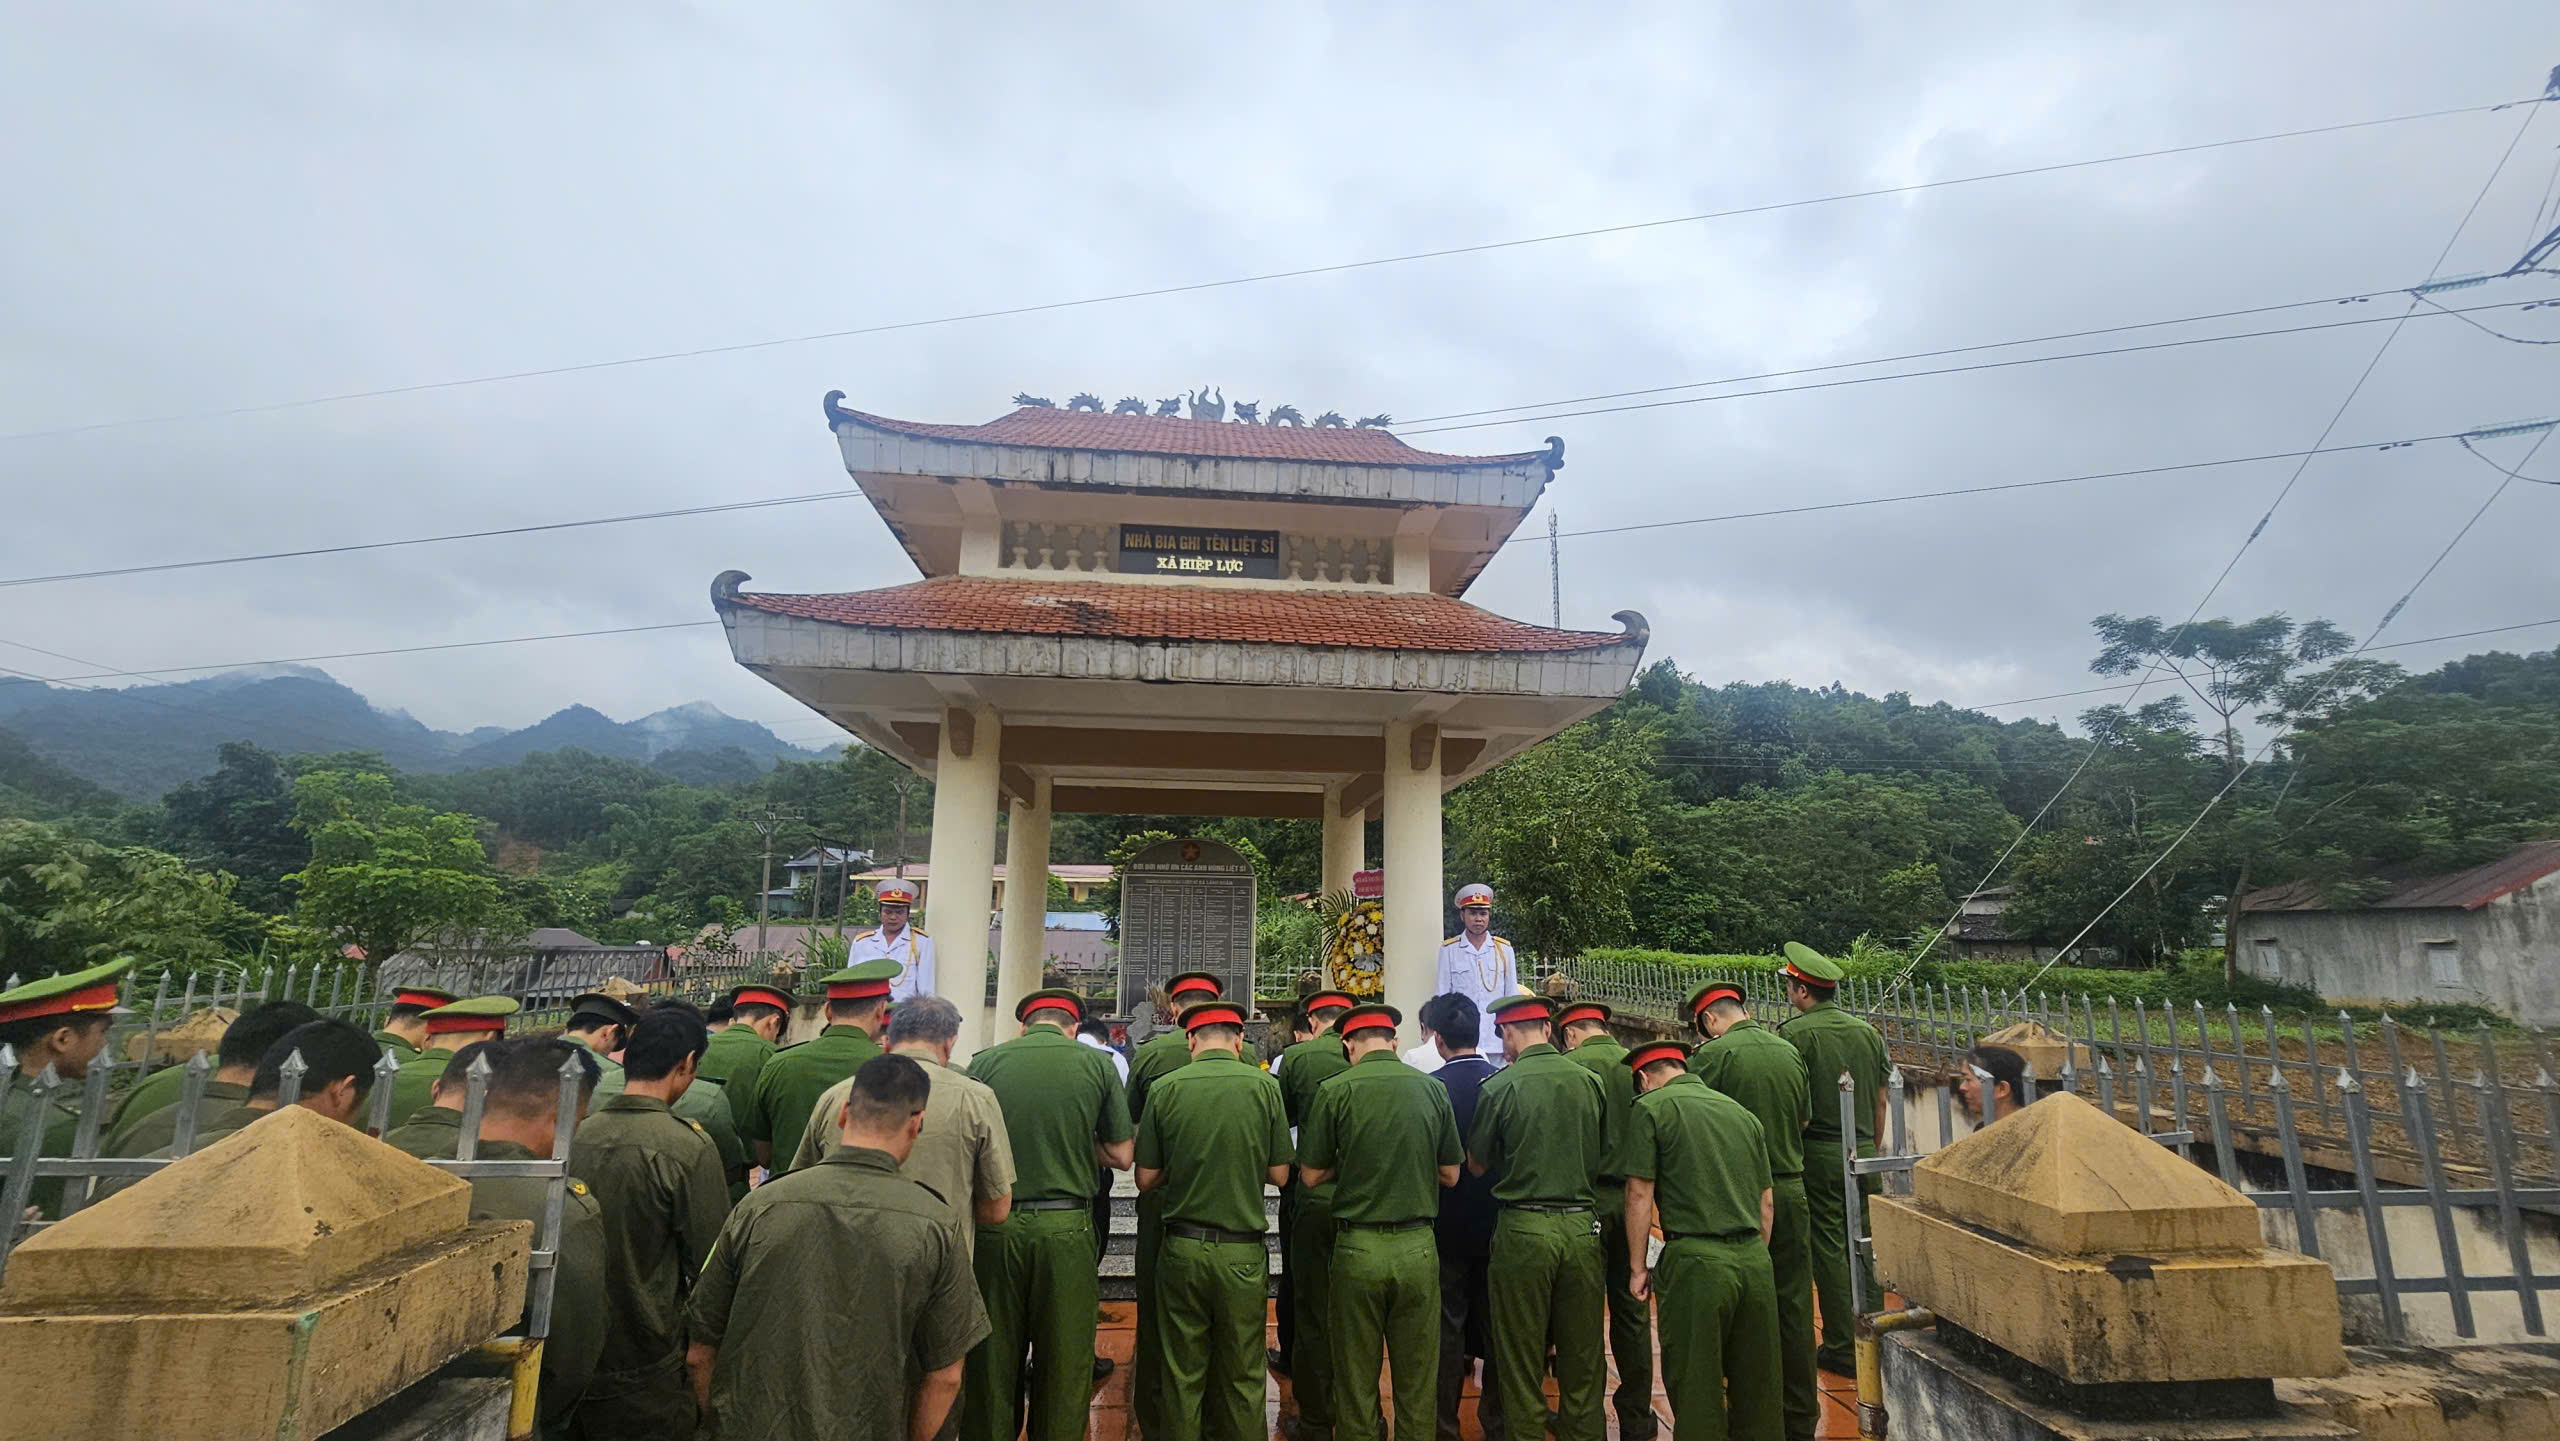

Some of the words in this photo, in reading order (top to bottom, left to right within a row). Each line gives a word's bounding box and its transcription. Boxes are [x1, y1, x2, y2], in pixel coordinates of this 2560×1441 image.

[1155, 535, 1176, 549] BIA
[1179, 535, 1200, 550] GHI
[1206, 533, 1229, 551] TÊN
[1232, 536, 1257, 555] LIỆT
[1156, 555, 1177, 569] XÃ
[1179, 556, 1213, 573] HIỆP
[1217, 559, 1243, 574] LỰC
